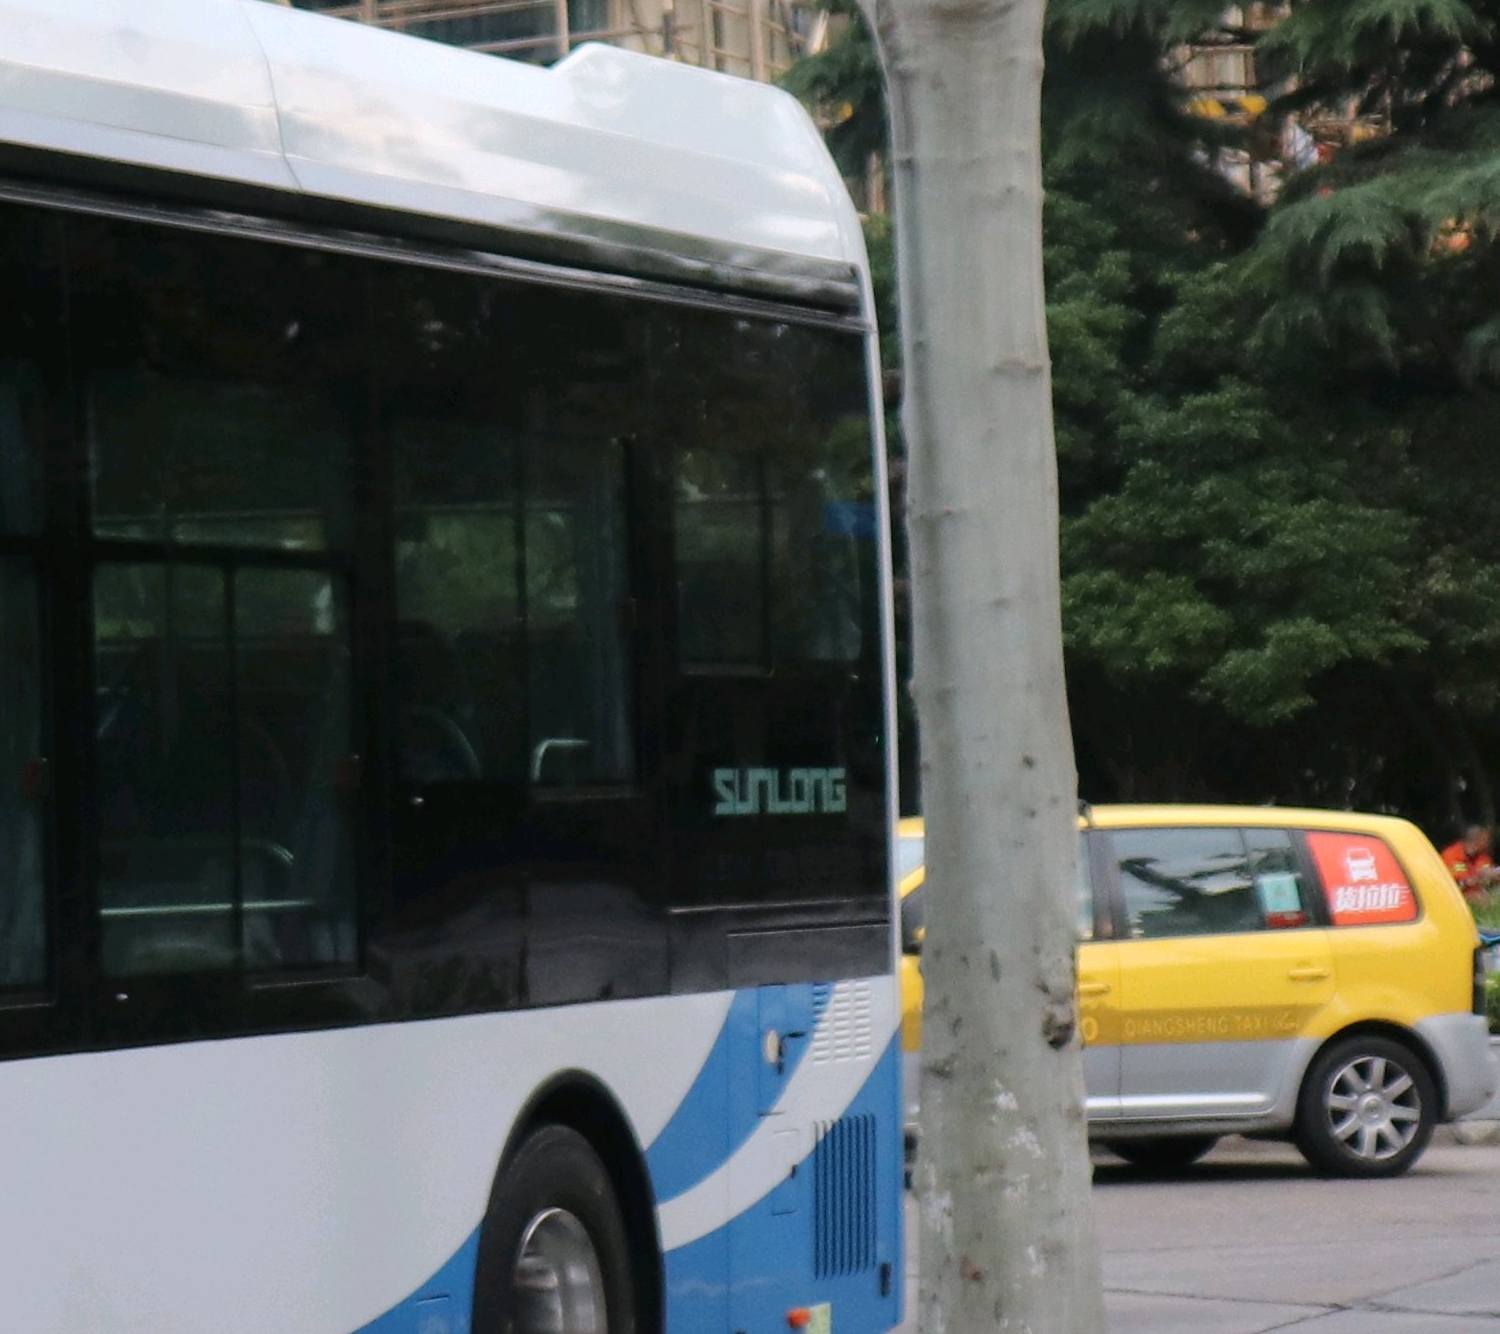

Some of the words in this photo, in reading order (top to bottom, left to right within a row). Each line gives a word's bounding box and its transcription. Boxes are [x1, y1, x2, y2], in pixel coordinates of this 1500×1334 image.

[713, 767, 847, 815] SUNLONG
[1124, 1017, 1229, 1039] QIANGSHENG
[1237, 1015, 1268, 1031] TAXI
